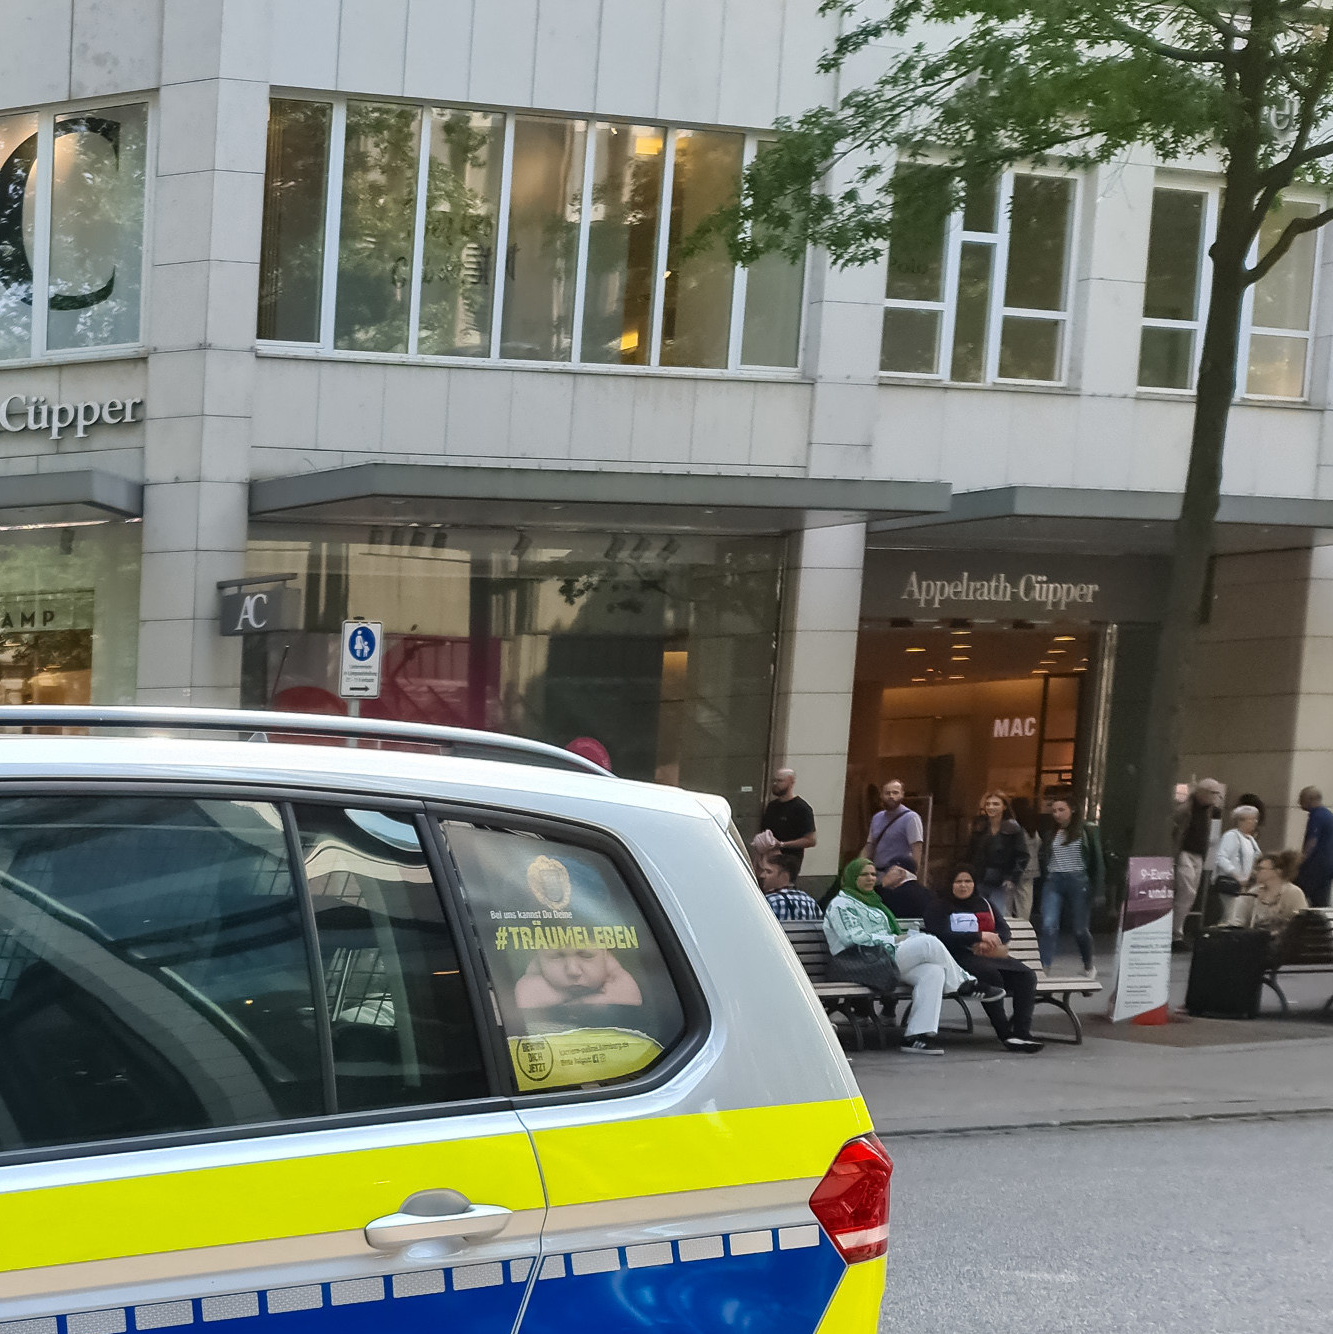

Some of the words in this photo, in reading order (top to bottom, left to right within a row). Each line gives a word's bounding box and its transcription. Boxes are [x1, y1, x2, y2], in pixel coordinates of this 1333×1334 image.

[901, 571, 1100, 610] Appelrath-Cüpper
[234, 593, 268, 631] AC
[993, 717, 1036, 738] MAC
[495, 921, 639, 950] #TRÄUMELEBEN
